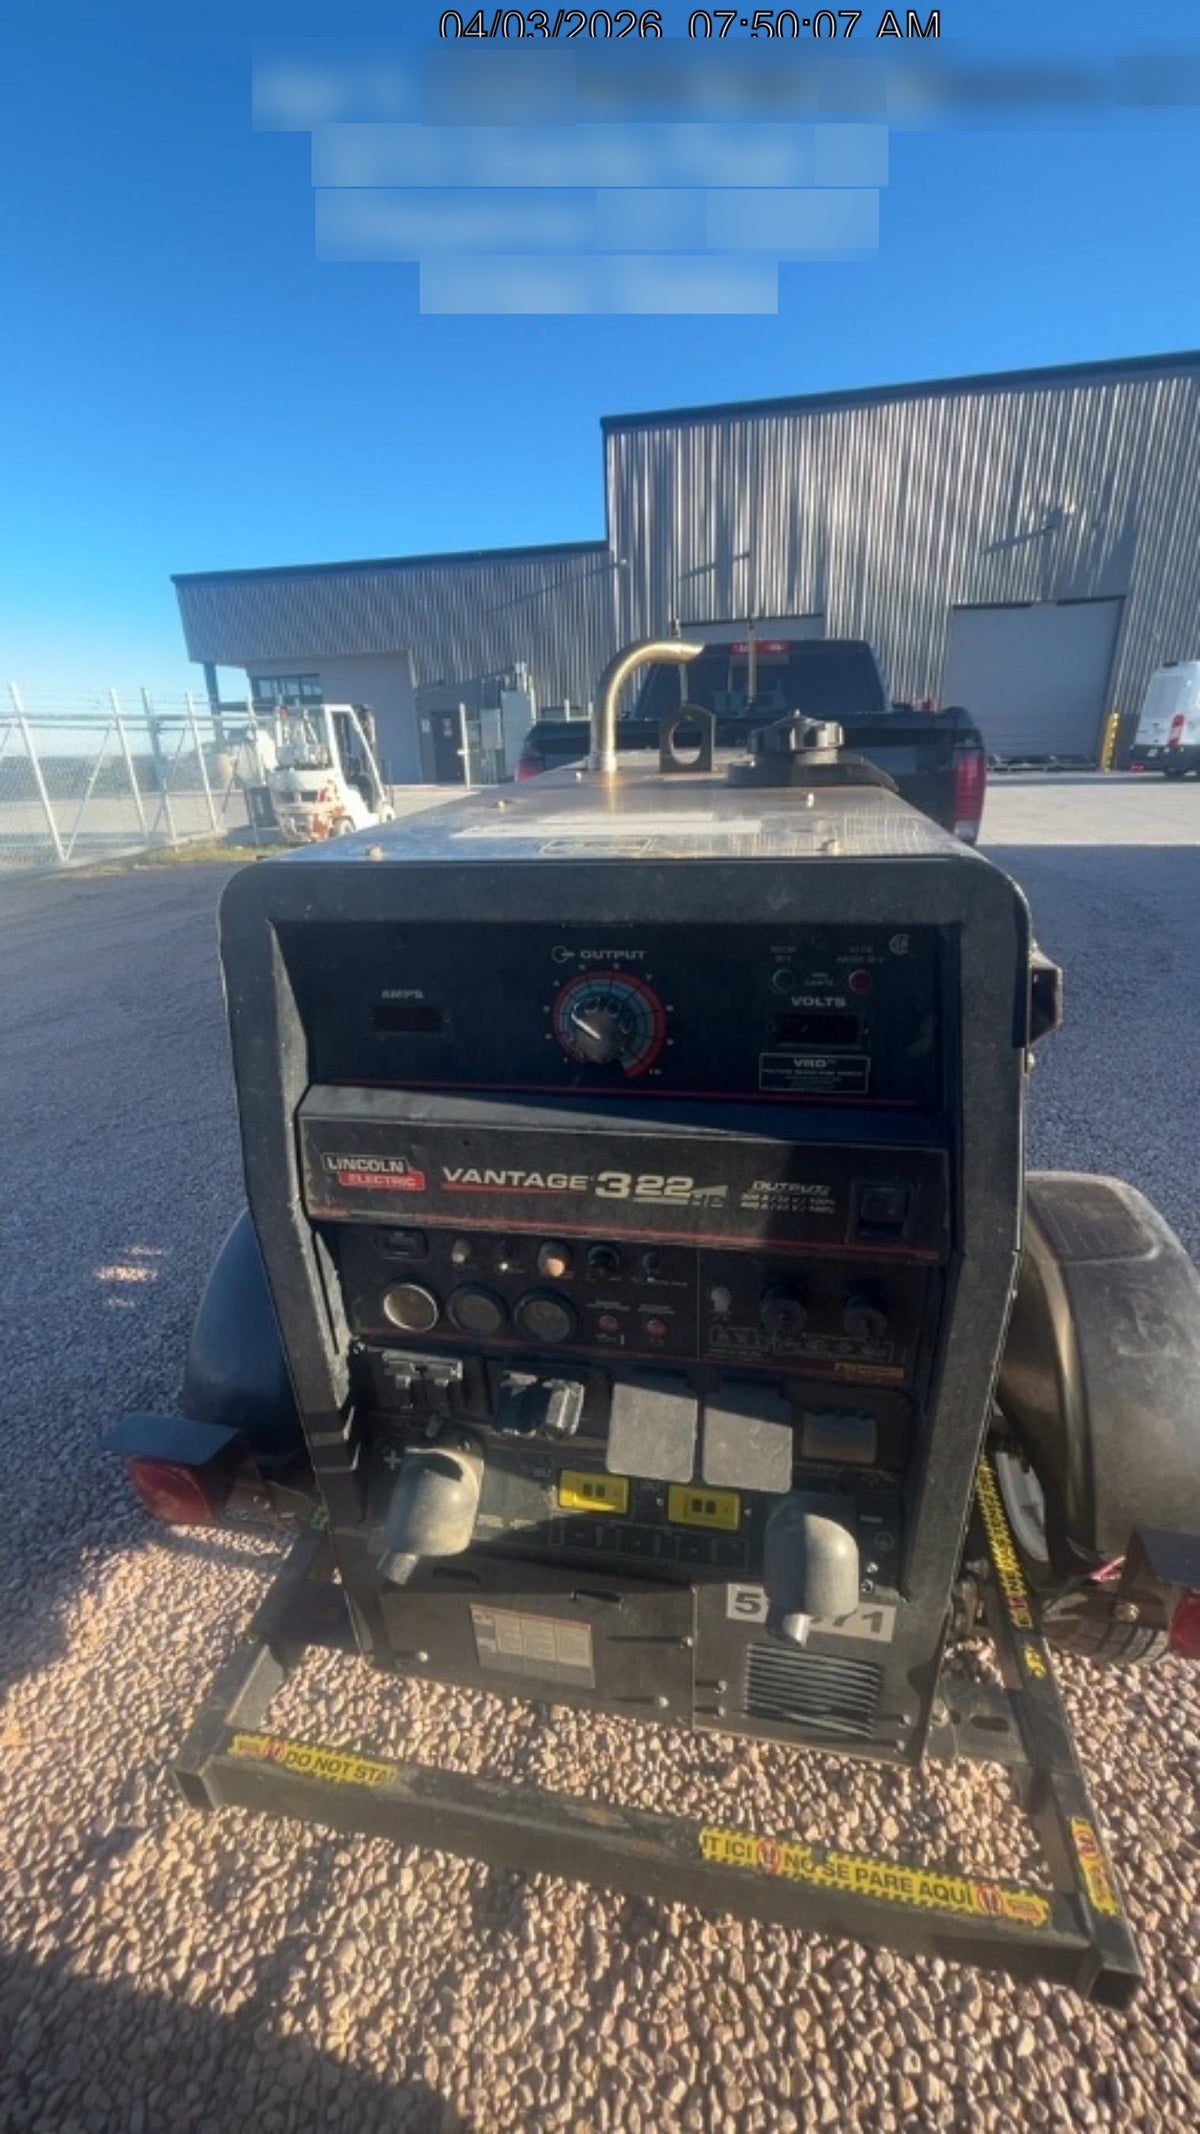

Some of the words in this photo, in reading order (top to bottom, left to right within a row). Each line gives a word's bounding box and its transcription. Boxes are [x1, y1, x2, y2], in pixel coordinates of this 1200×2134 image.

[580, 950, 647, 960] OUTPUT
[381, 989, 424, 999] AMPS
[791, 996, 847, 1007] VOLTS
[326, 1155, 405, 1174] LINCOLN
[348, 1174, 416, 1189] ELECTRIC
[442, 1166, 588, 1190] VANTAGE
[595, 1171, 694, 1199] 322
[285, 1751, 311, 1768] DO
[313, 1756, 353, 1776] NOT
[784, 1853, 816, 1875] NO
[822, 1861, 850, 1879] SE
[855, 1867, 914, 1894] PARE
